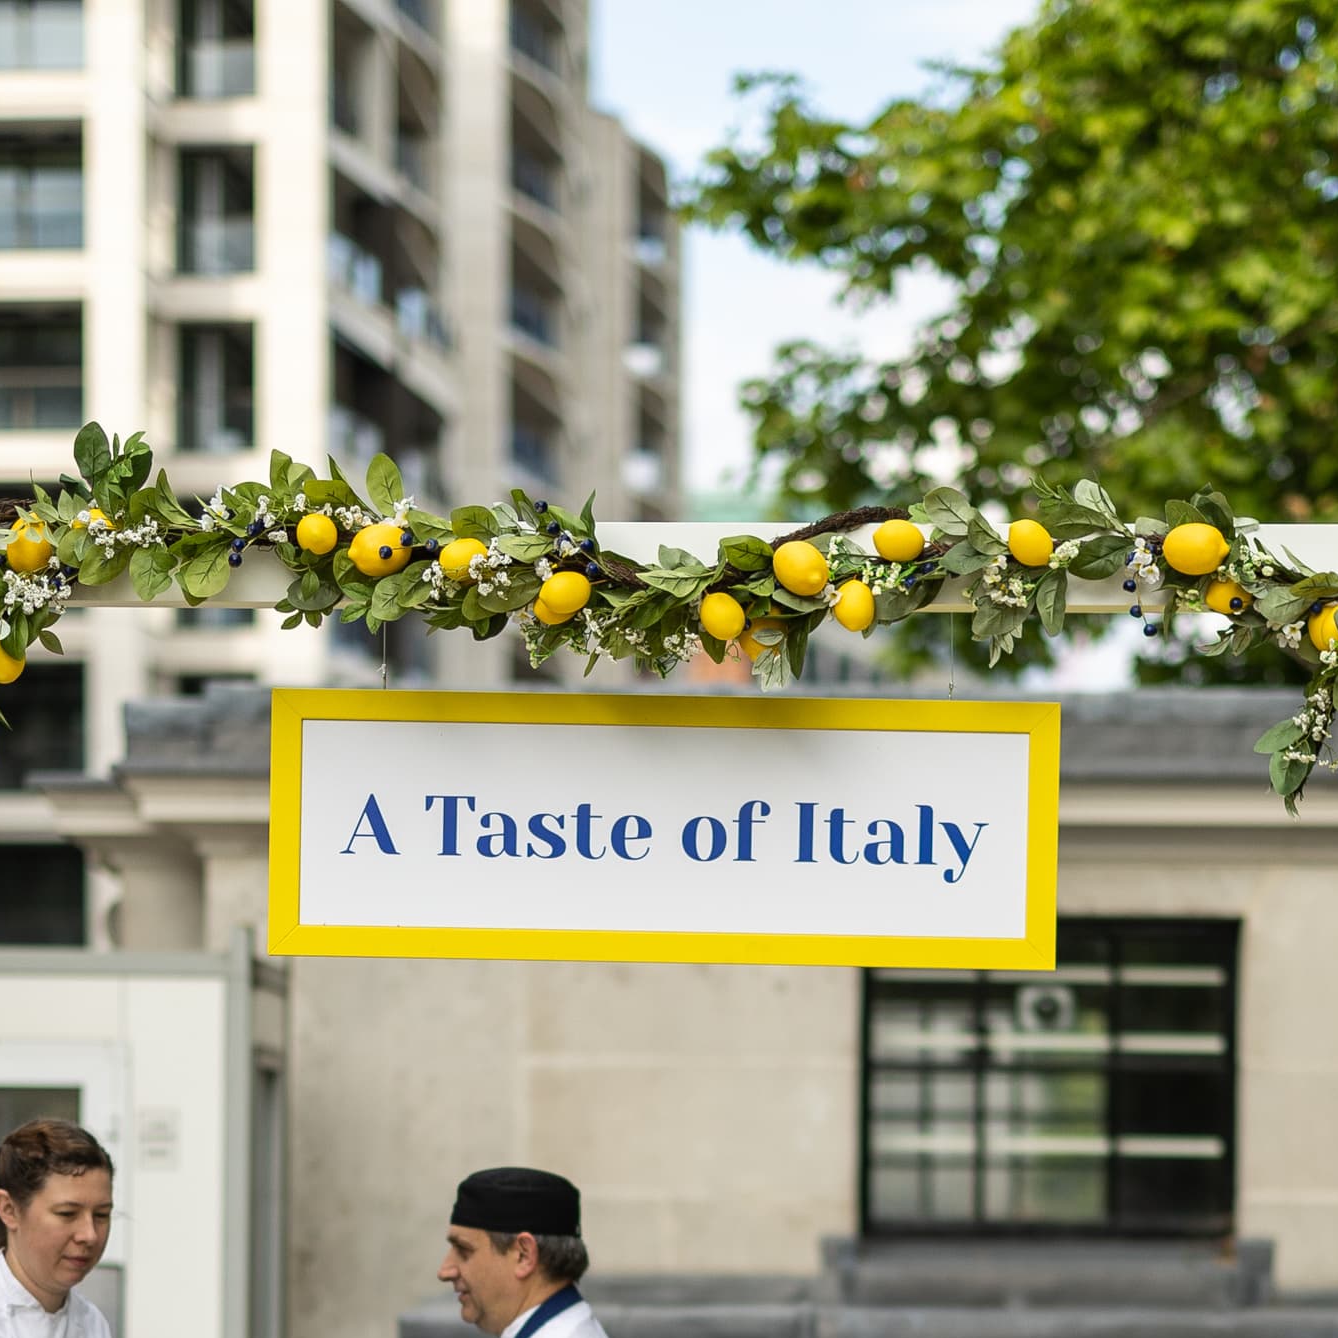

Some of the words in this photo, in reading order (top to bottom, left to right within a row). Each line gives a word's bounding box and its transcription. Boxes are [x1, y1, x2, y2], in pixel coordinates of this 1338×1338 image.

[339, 793, 401, 856] A
[425, 794, 653, 861] Taste
[681, 800, 772, 863] of
[793, 802, 990, 884] Italy
